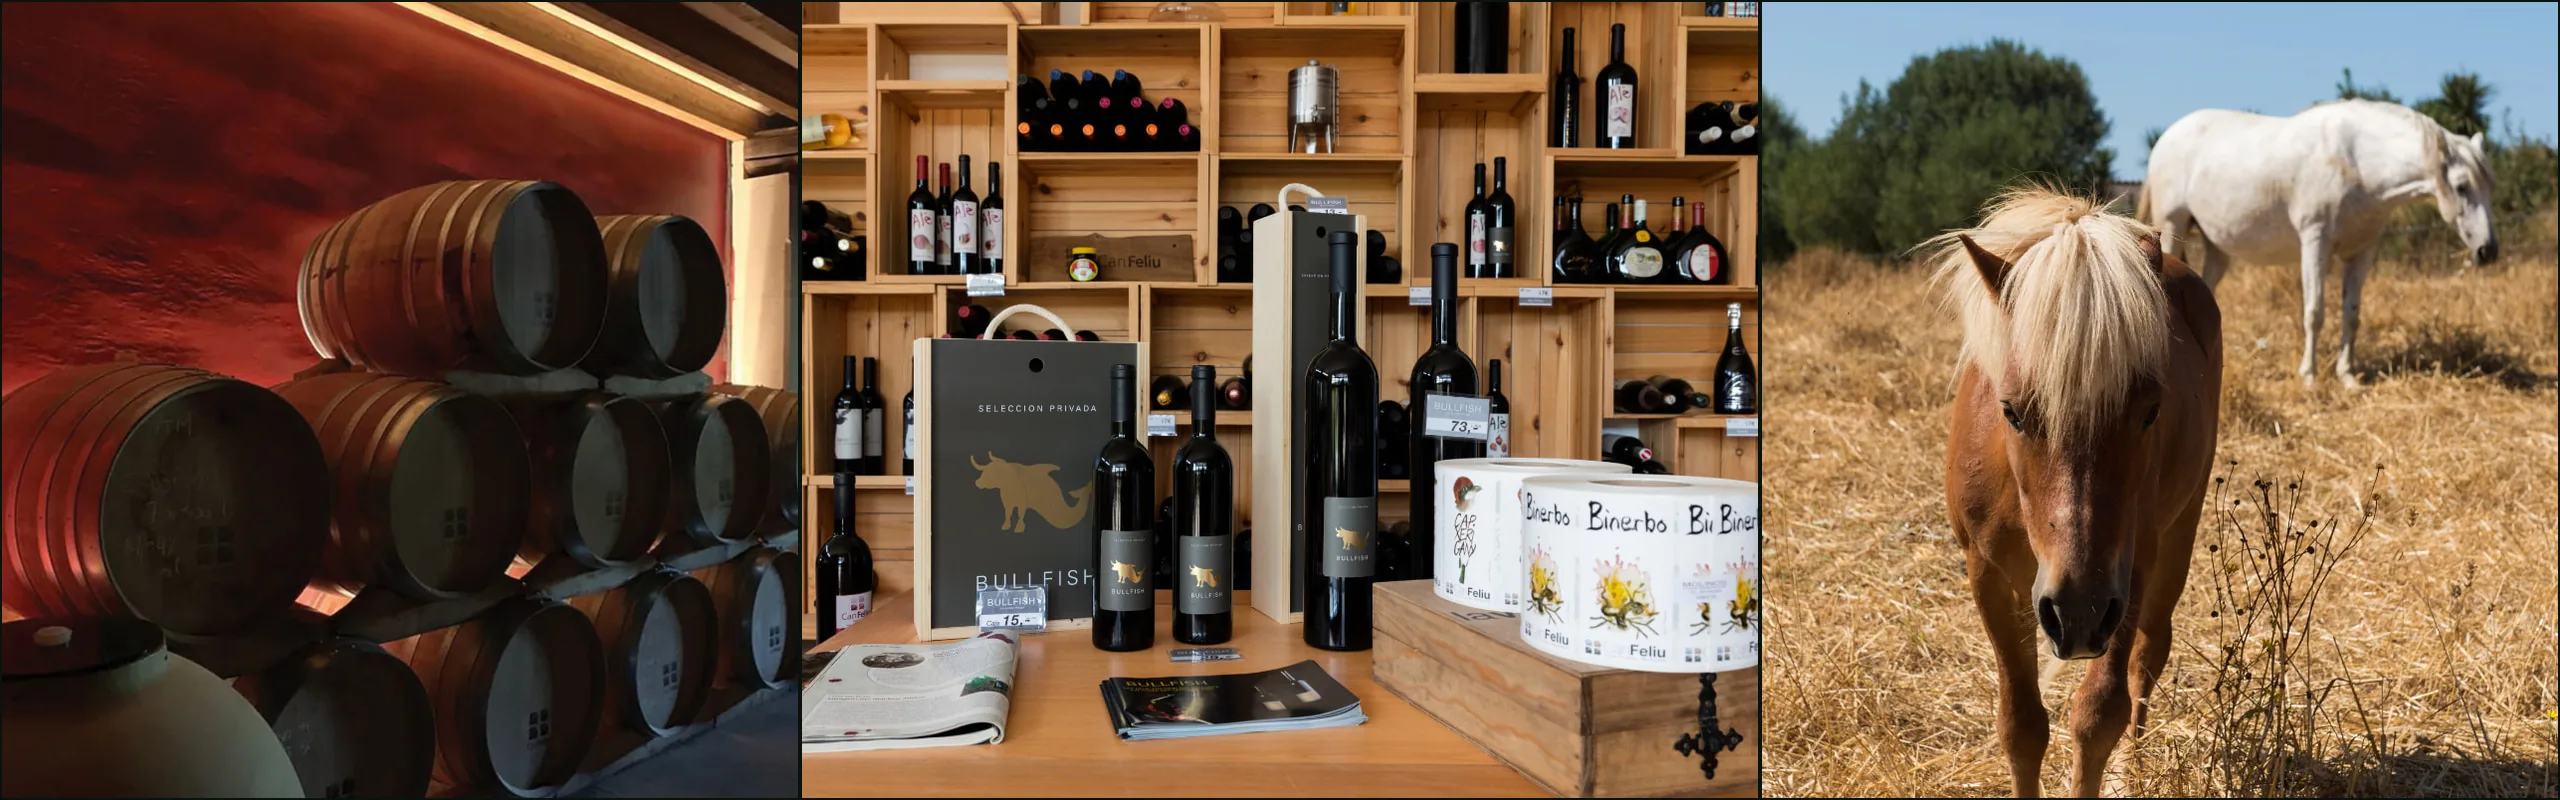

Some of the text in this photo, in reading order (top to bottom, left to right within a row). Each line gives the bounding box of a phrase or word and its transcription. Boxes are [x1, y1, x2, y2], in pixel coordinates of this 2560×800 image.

[978, 404, 1097, 412] SELECCION PRIVADA
[1434, 402, 1481, 413] BULLFISH
[1526, 492, 1570, 526] Binerbo
[1587, 500, 1667, 533] Binerbo
[976, 568, 1092, 591] BULLFISH
[1467, 587, 1491, 600] Feliu
[987, 597, 1035, 606] BULLFISH
[1544, 628, 1569, 646] Feliu
[1630, 644, 1666, 658] Feliu
